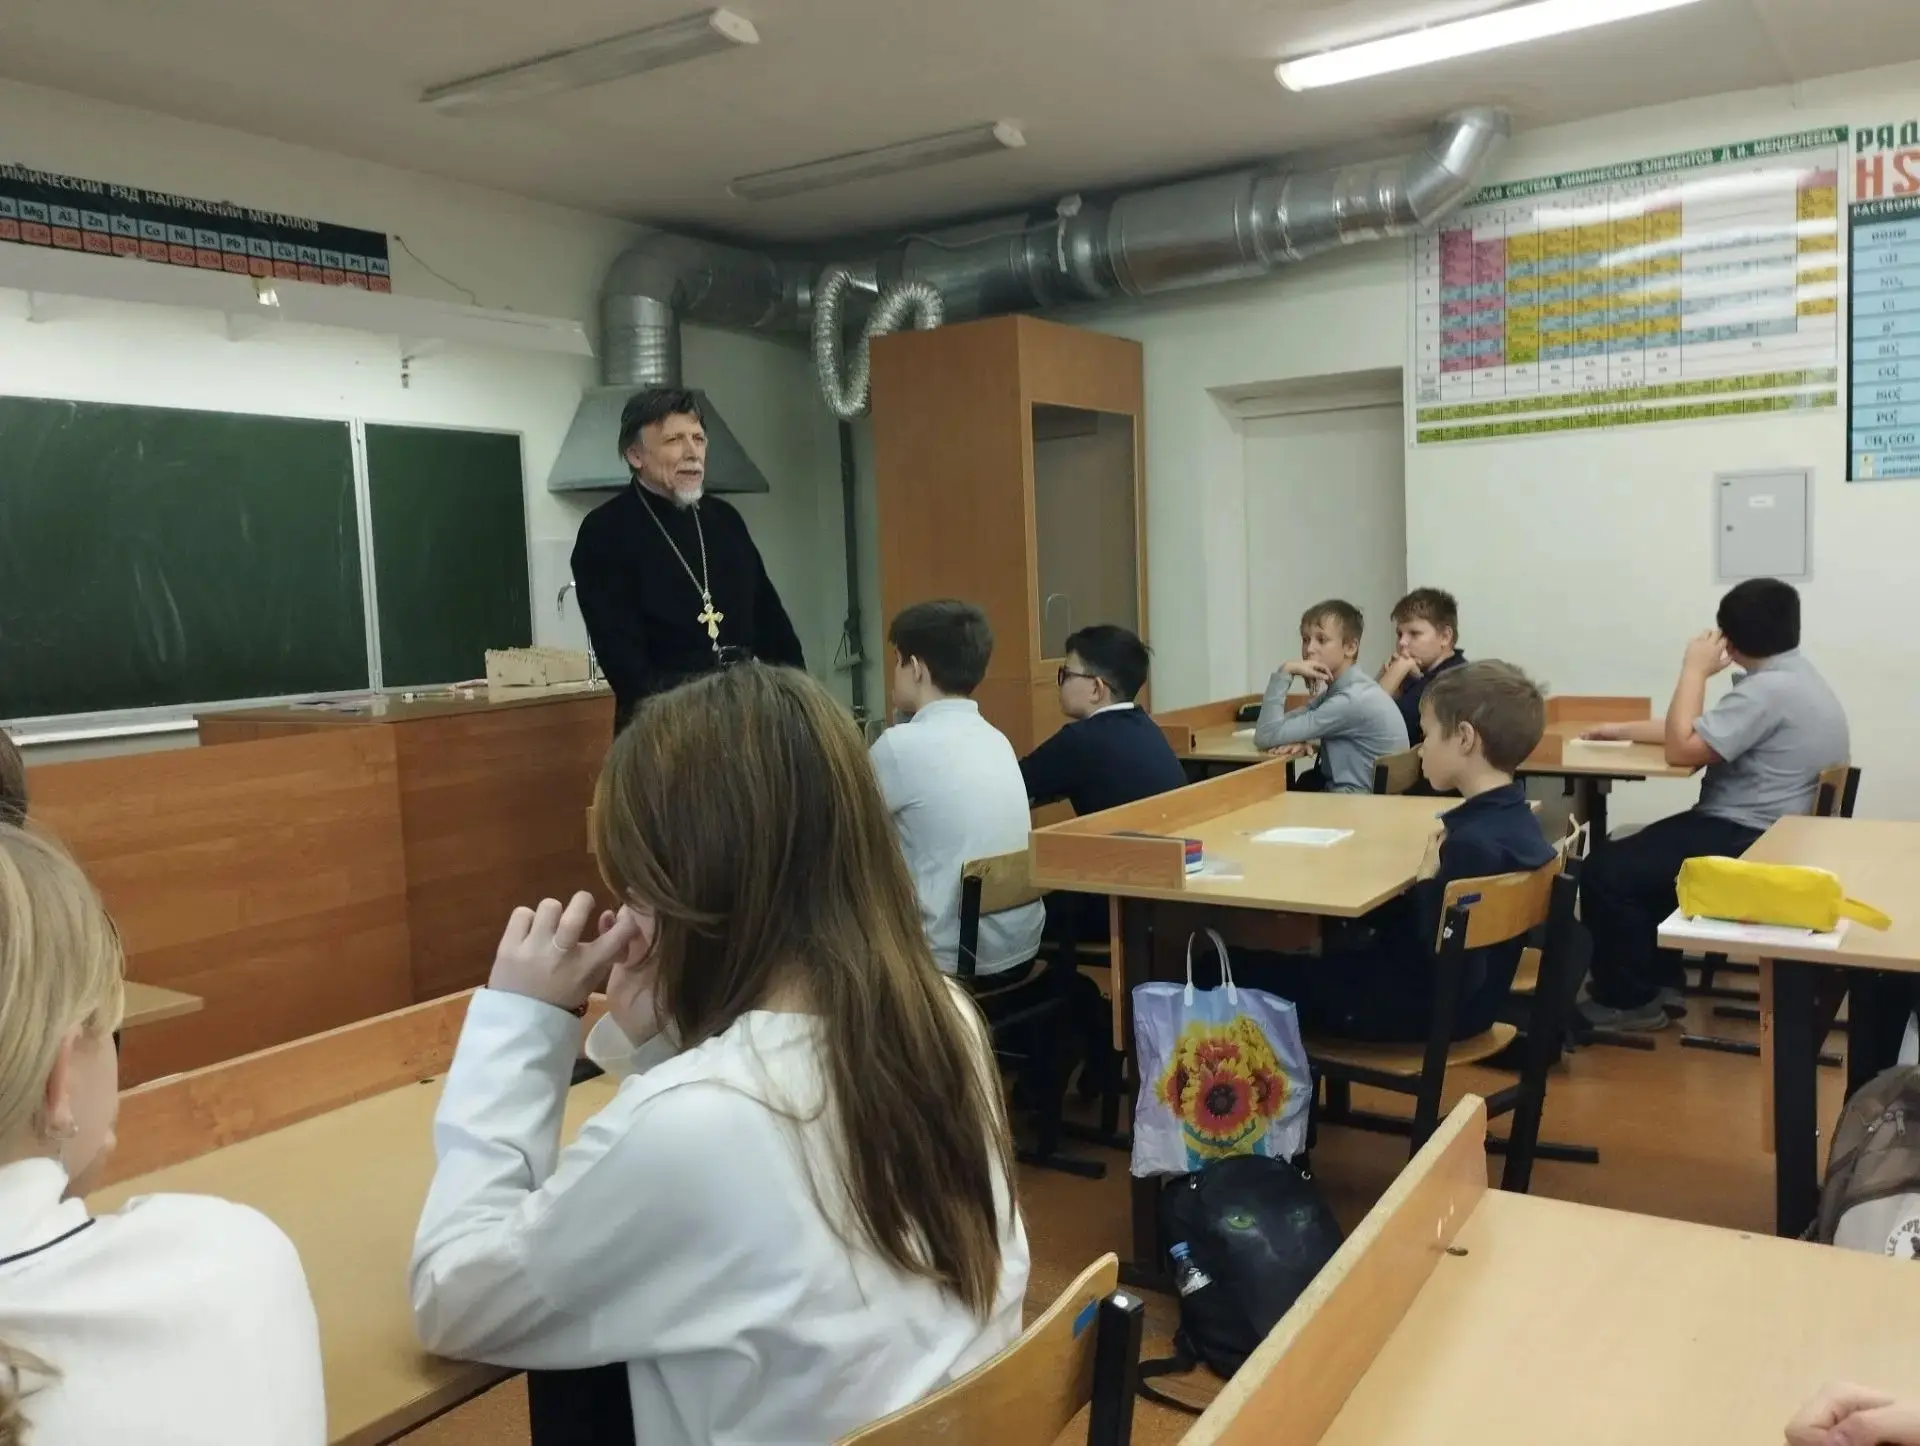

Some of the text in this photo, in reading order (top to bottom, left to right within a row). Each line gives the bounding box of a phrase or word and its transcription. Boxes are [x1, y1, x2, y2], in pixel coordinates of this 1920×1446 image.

[1506, 177, 1556, 198] СИСТЕМА
[1754, 128, 1838, 153] МЕНДЕЛЕЕВА
[24, 204, 44, 220] Mg
[88, 215, 103, 227] Zn
[145, 224, 161, 236] Co
[372, 262, 385, 271] Au
[110, 184, 140, 204] РЯД
[145, 190, 243, 220] НАПРЯЖЕНИЙ
[248, 208, 320, 232] МЕТАЛЛОВ
